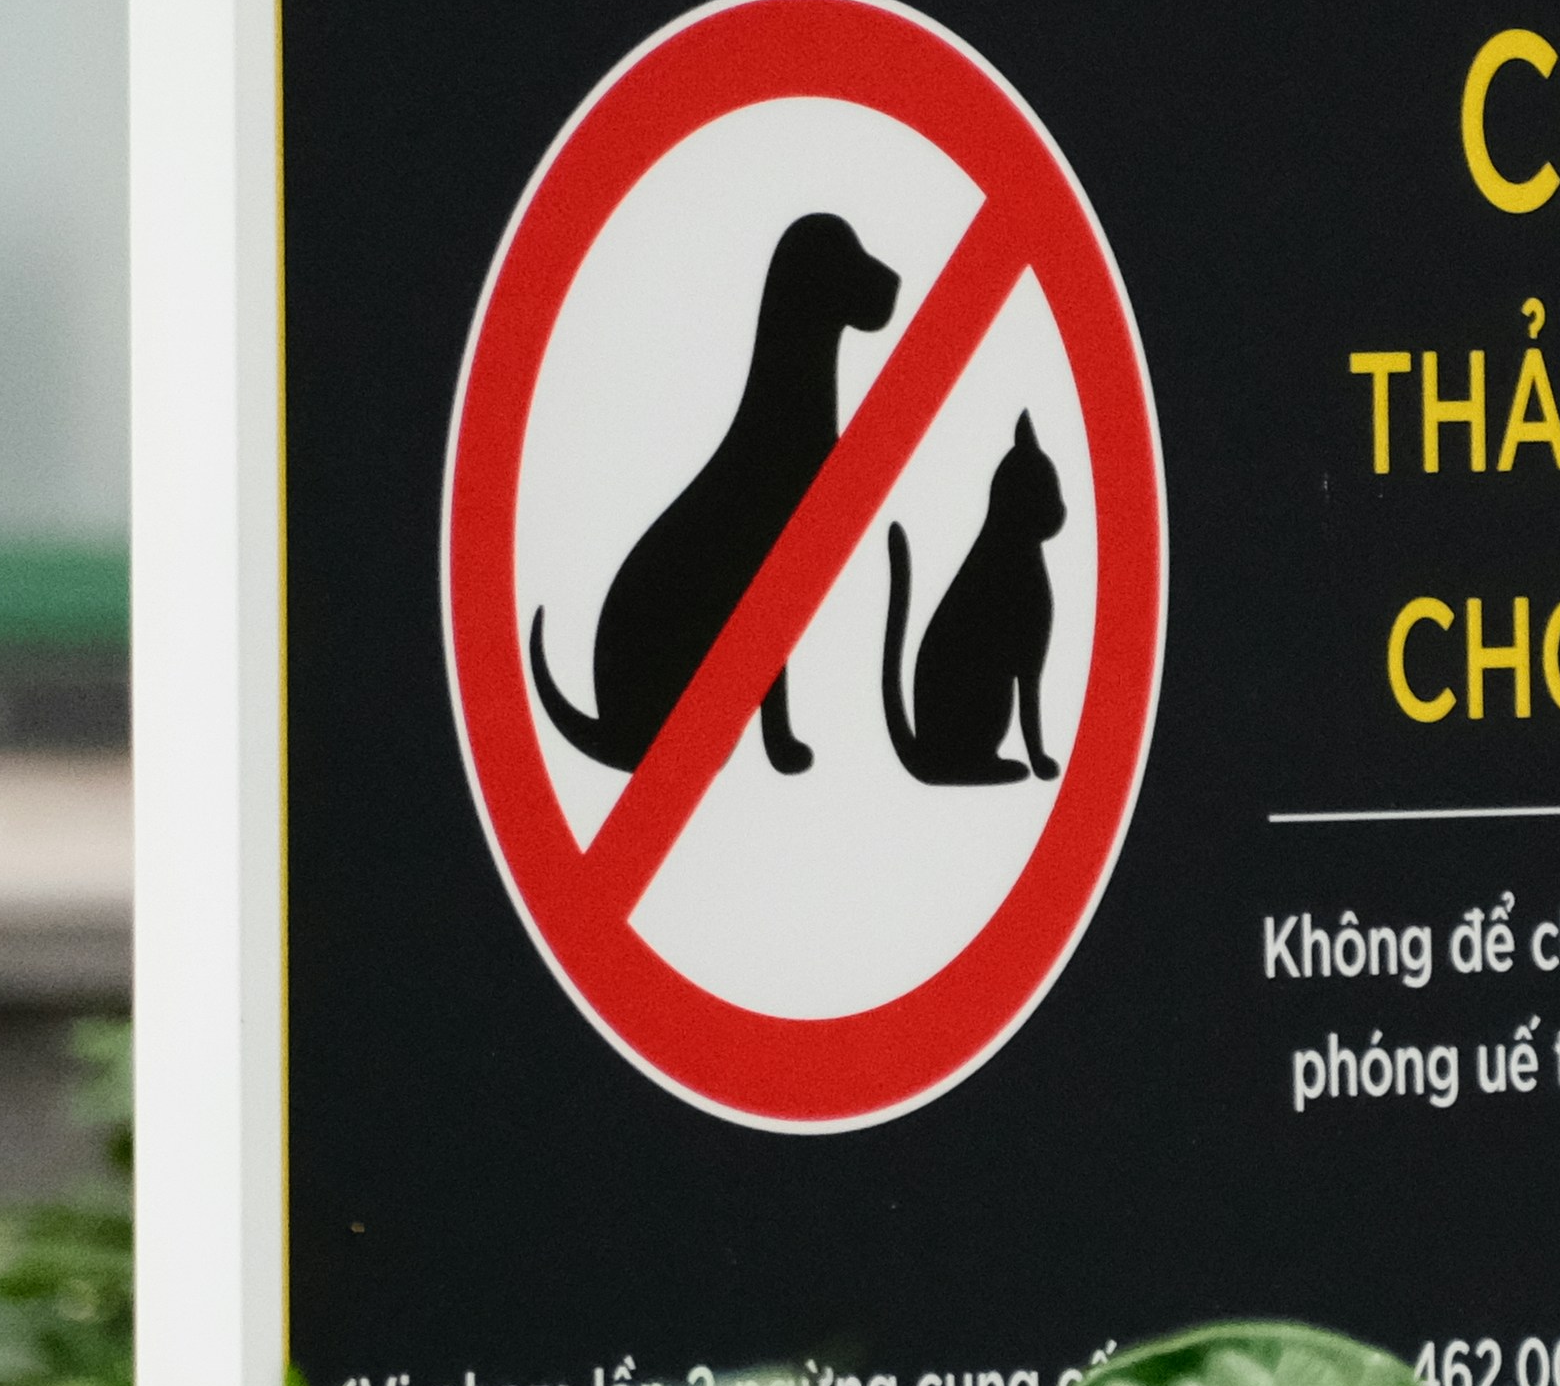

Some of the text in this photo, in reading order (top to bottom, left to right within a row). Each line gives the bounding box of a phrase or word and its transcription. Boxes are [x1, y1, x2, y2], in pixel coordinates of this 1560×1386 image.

[1264, 911, 1432, 988] Không
[1450, 891, 1515, 973] để
[1293, 1030, 1458, 1112] phóng
[1477, 1016, 1540, 1093] uế
